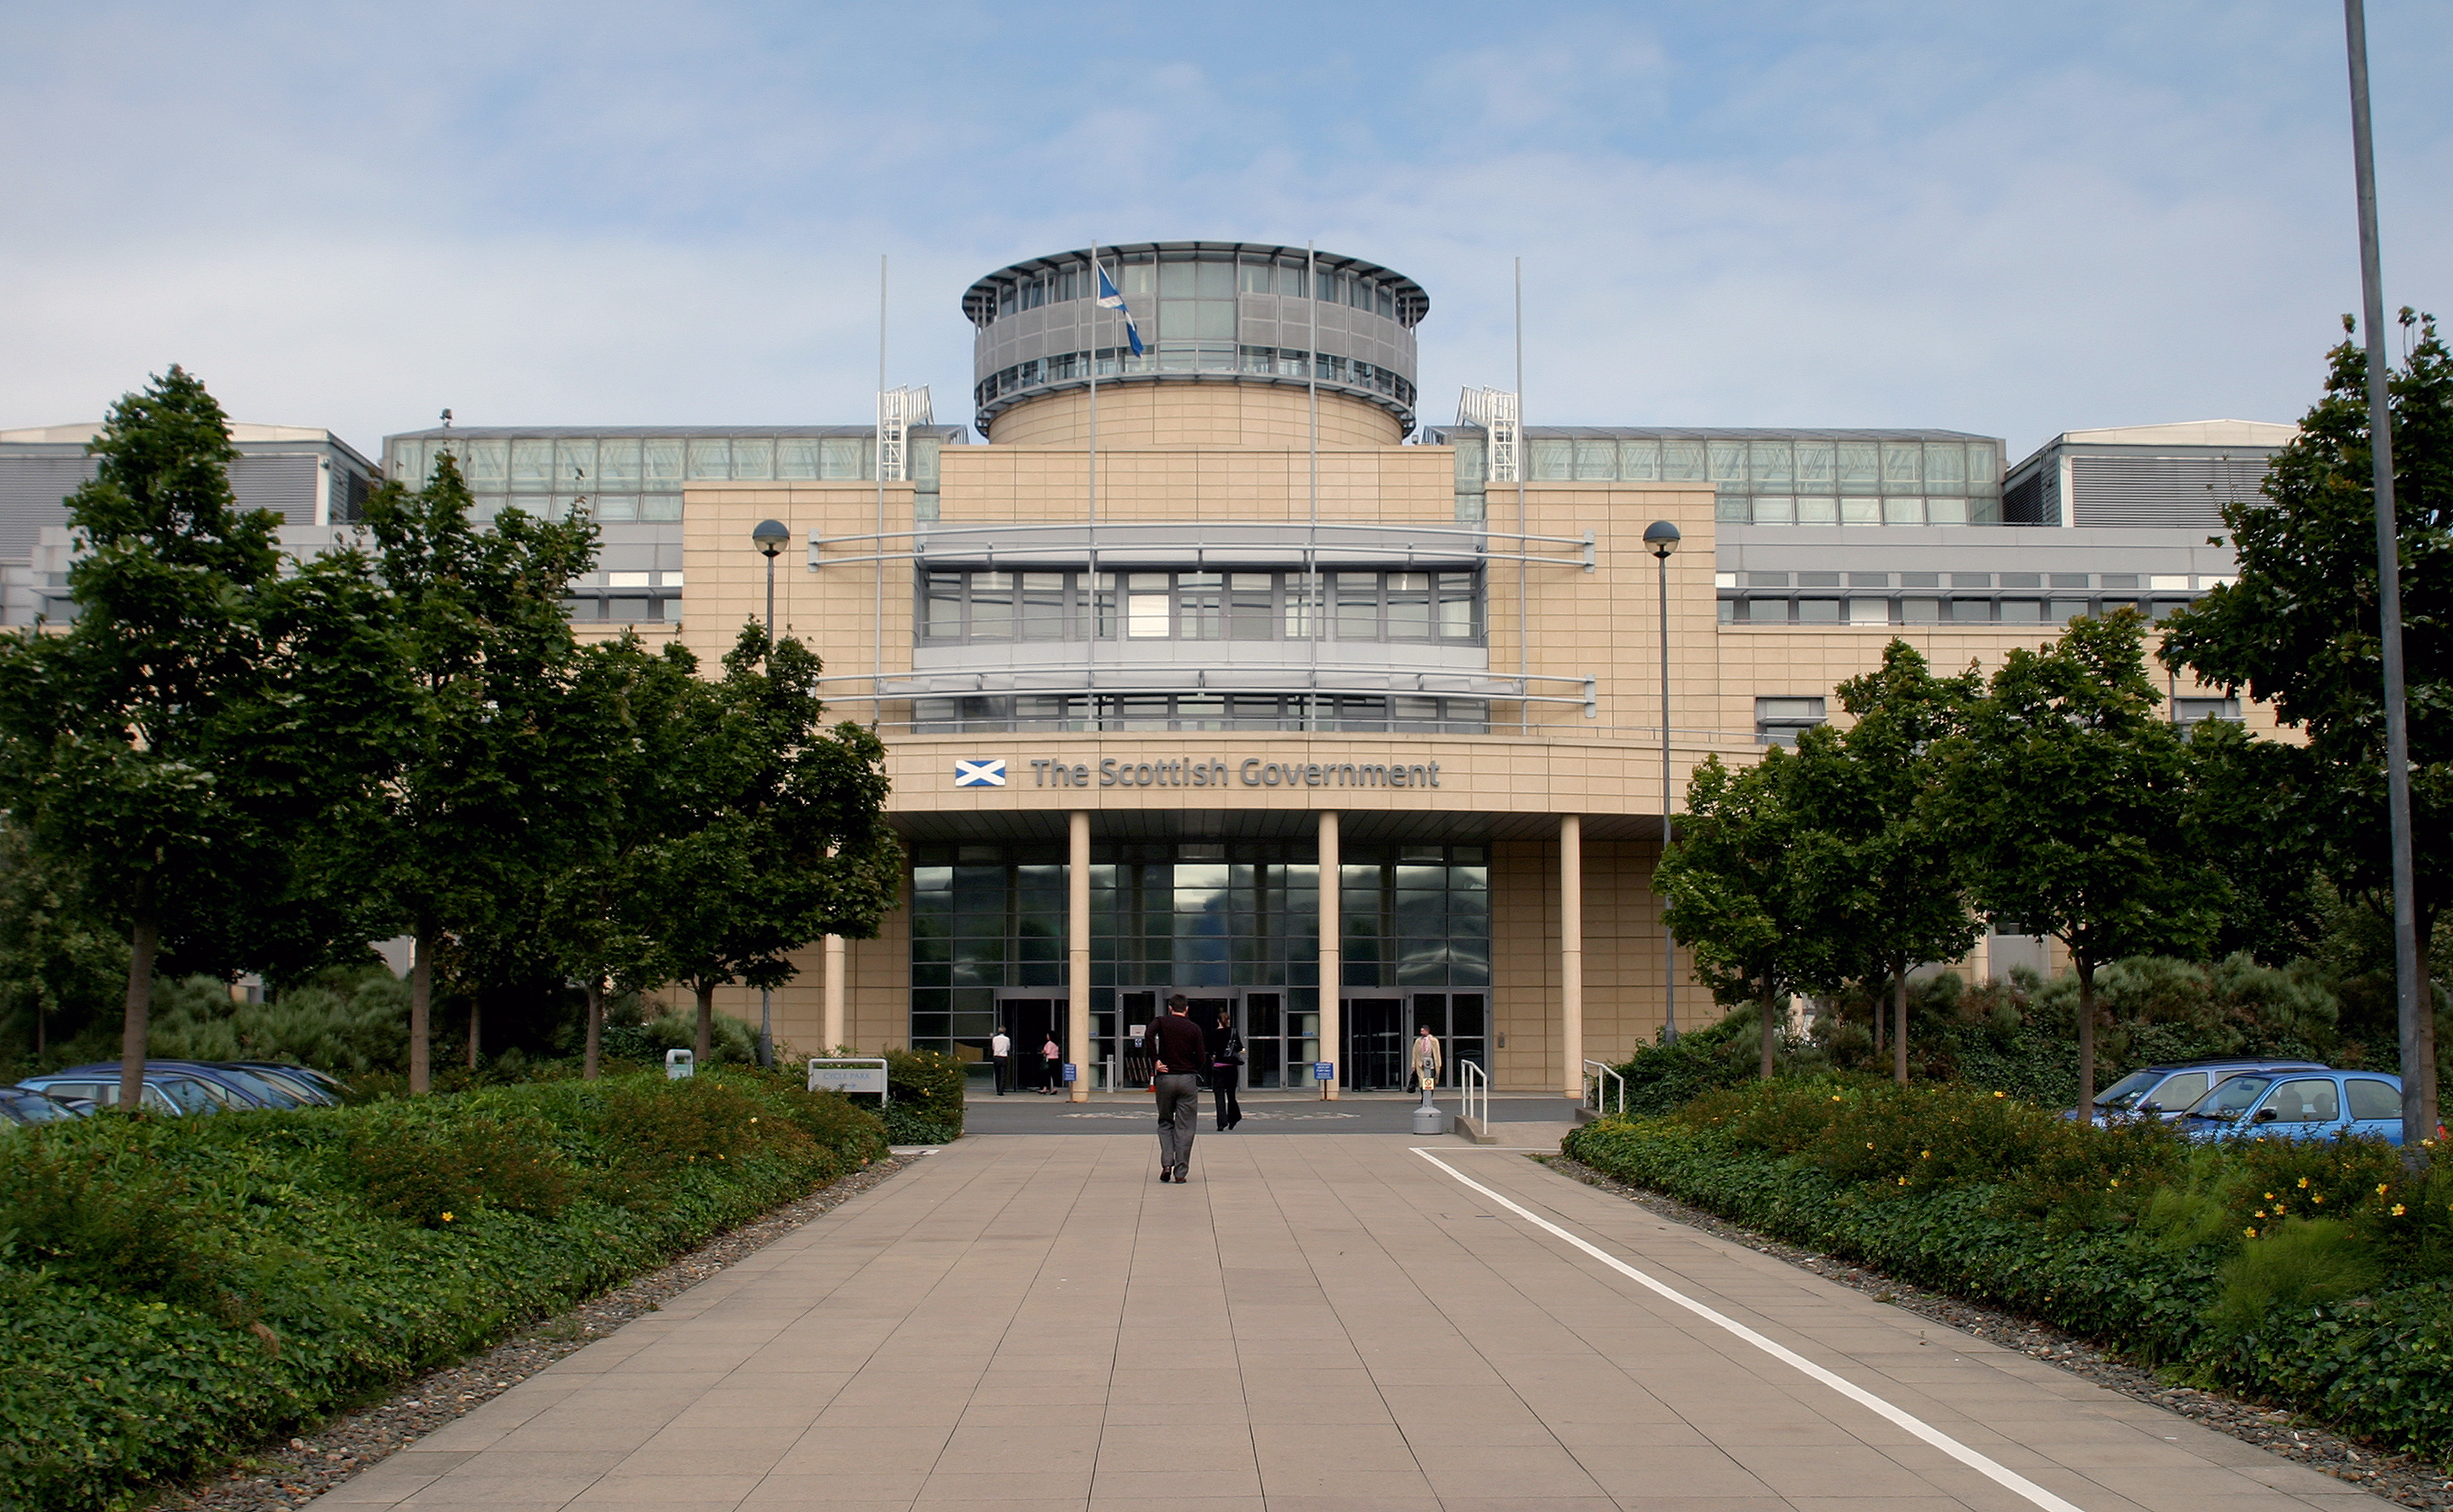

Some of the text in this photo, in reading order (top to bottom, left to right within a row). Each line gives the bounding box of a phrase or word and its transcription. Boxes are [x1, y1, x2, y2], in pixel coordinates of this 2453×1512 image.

[1031, 757, 1440, 787] The Scottish Government
